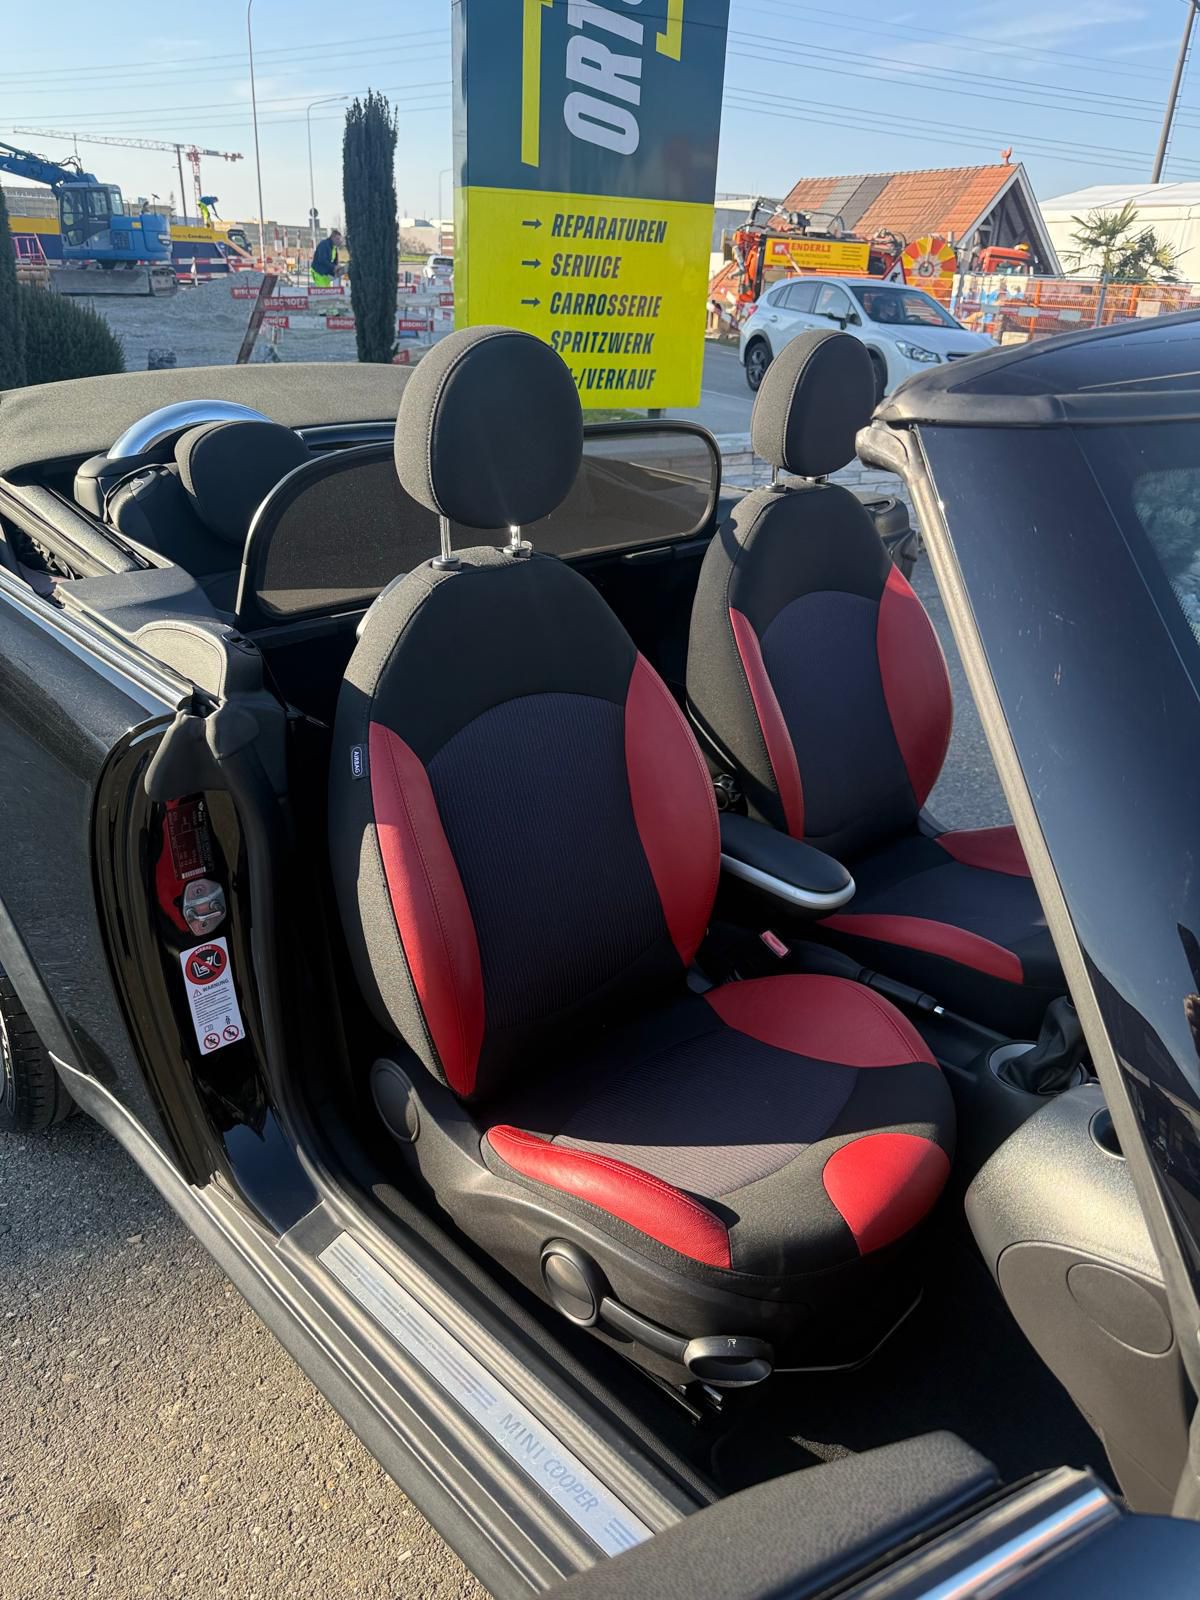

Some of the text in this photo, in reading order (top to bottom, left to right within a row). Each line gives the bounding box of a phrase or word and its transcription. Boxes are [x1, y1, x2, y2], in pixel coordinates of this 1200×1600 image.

[563, 0, 644, 156] ORT
[551, 213, 668, 243] REPARATUREN
[791, 243, 831, 253] ENDERLI
[550, 253, 622, 279] SERVICE
[549, 292, 662, 317] CARROSSERIE
[550, 330, 655, 354] SPRITZWERK
[569, 367, 657, 390] -/VERKAUF
[353, 751, 361, 774] AIRBAG
[499, 1412, 600, 1513] MINI COOPER
